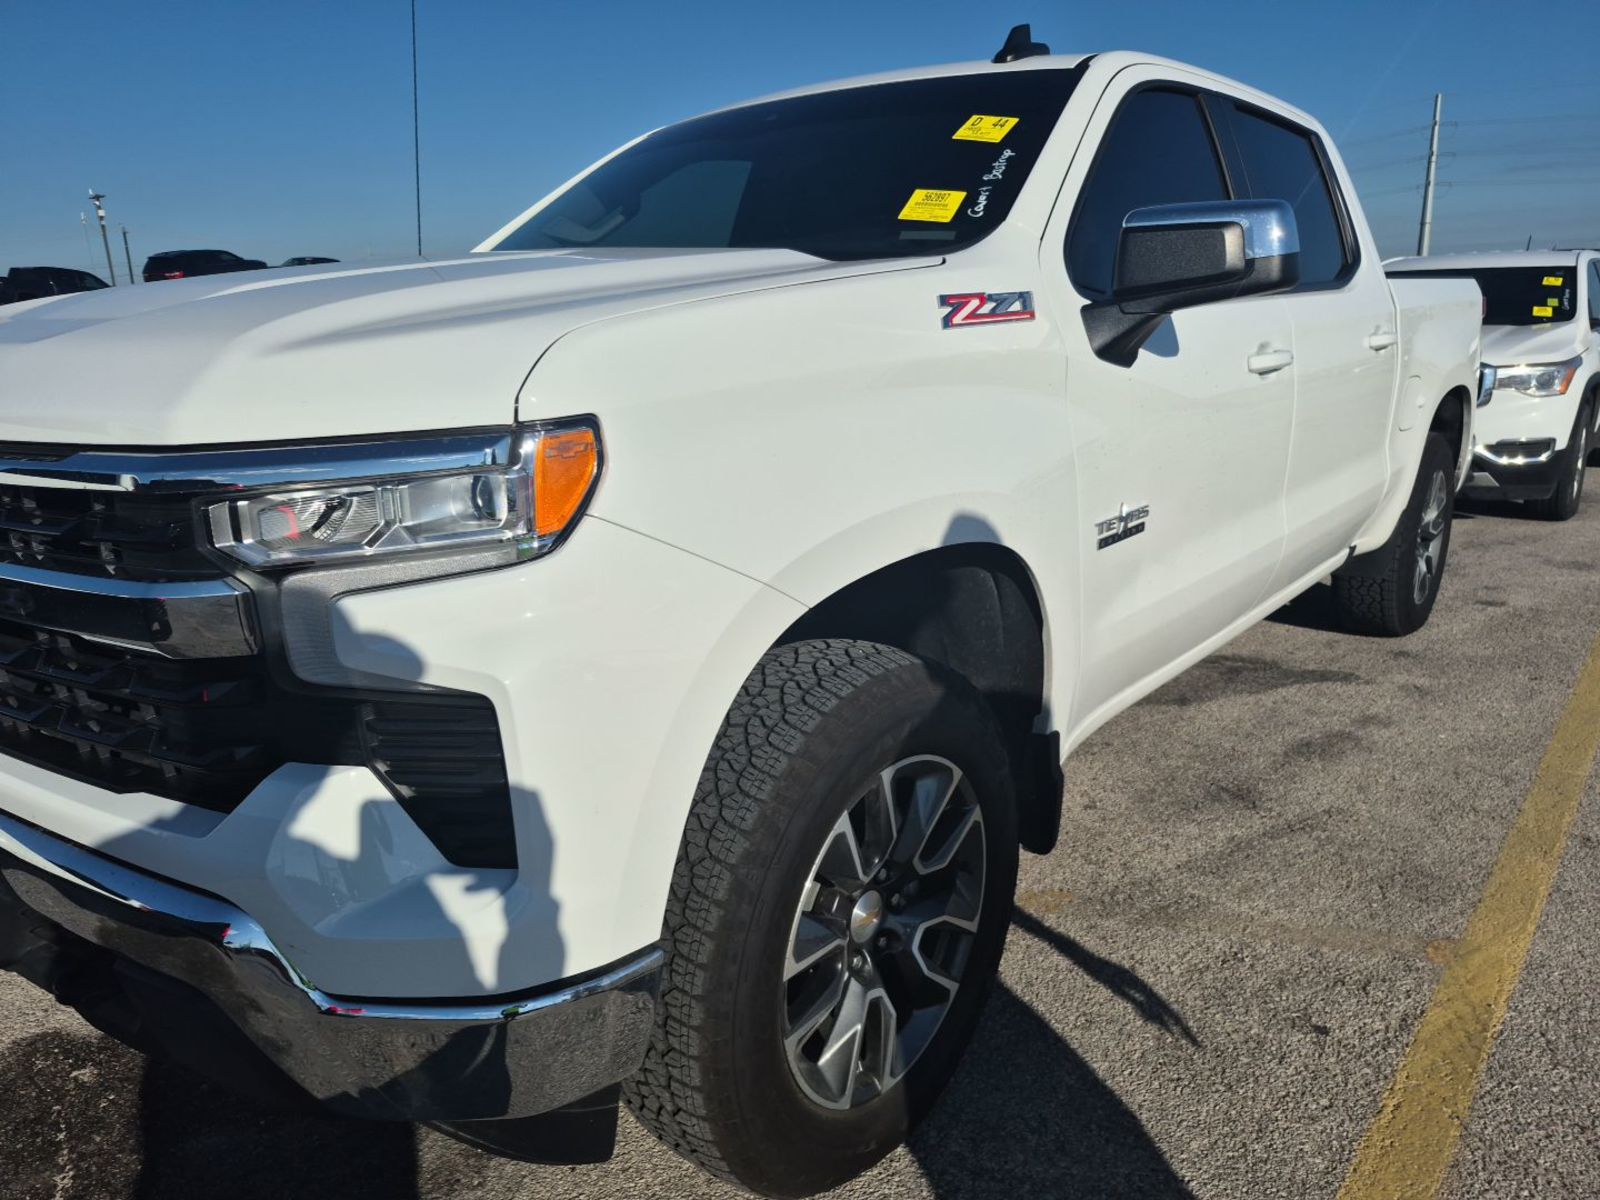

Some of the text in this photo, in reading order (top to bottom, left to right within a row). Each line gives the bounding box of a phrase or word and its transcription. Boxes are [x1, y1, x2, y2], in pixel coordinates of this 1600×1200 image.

[971, 116, 1009, 128] D 44
[937, 291, 1036, 330] Z71
